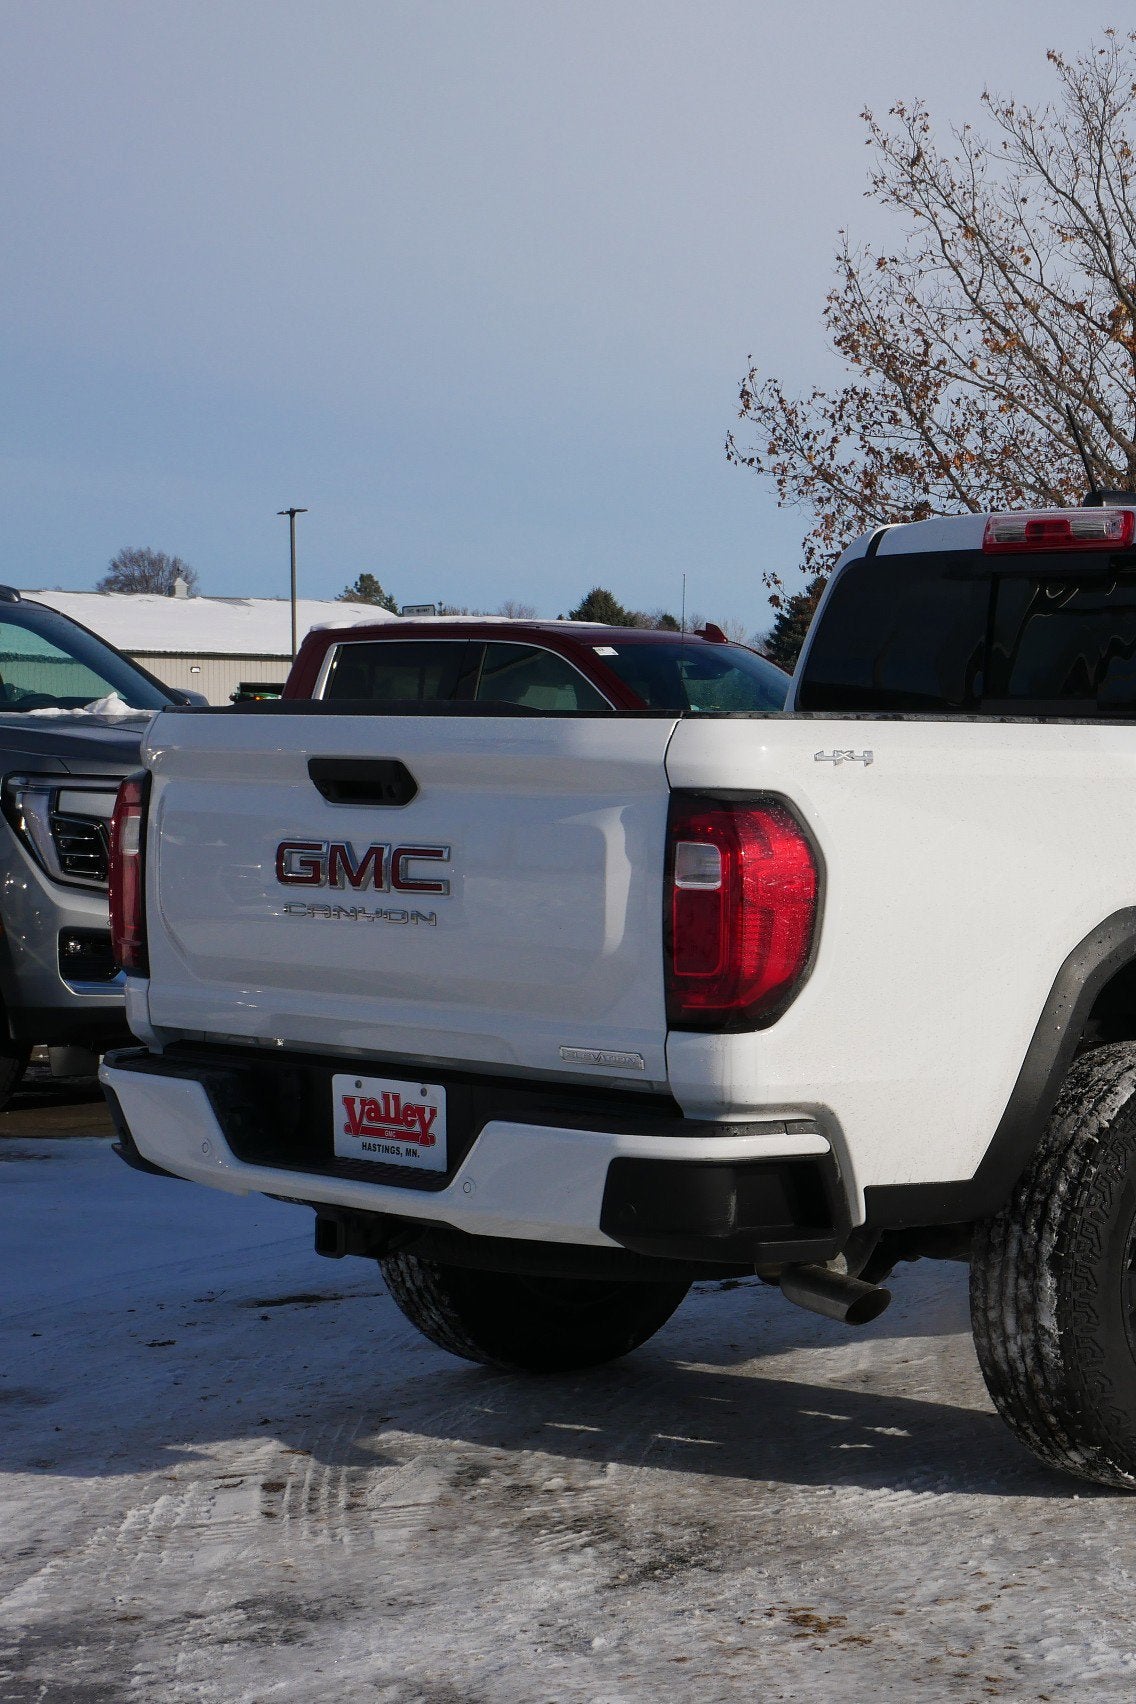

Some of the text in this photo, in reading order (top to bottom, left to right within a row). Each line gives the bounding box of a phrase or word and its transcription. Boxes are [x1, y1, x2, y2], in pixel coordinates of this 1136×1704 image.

[275, 837, 451, 896] GMC
[283, 901, 437, 927] CANYON
[342, 1090, 438, 1147] Valley
[384, 1129, 397, 1138] GMC
[361, 1141, 420, 1158] HASTINGS, MN.
